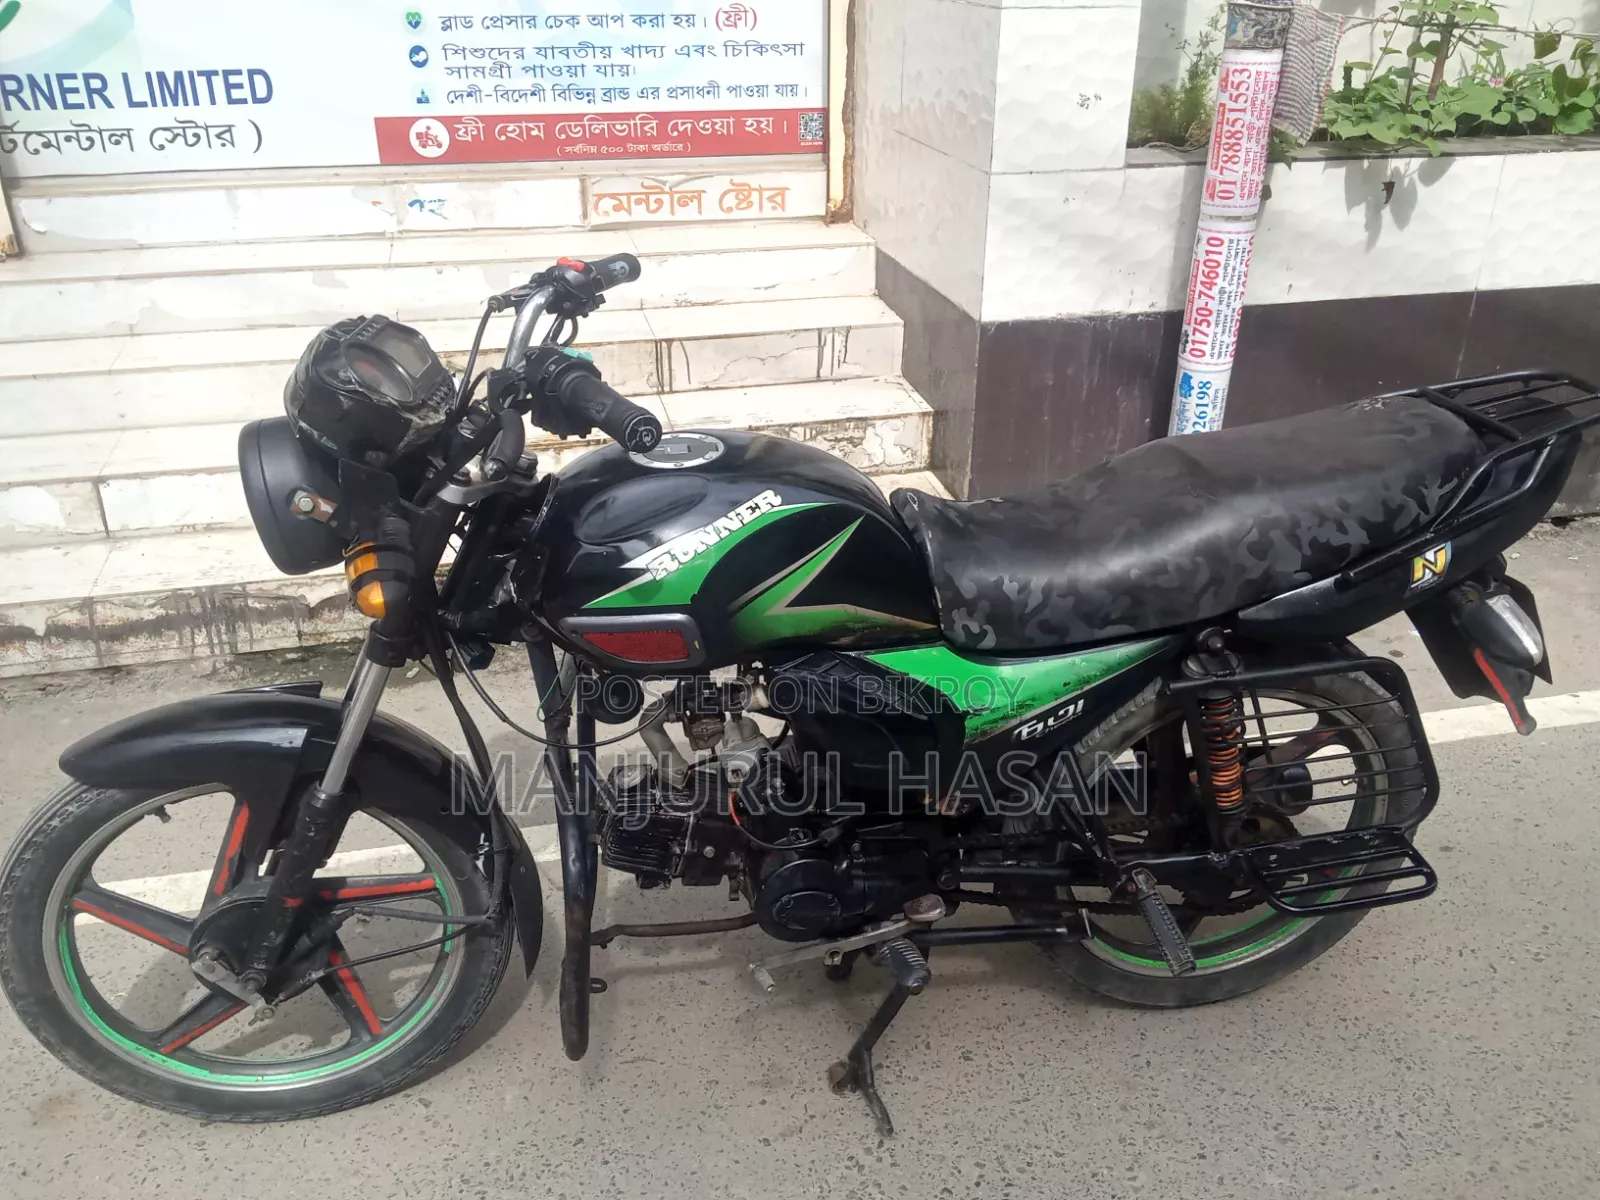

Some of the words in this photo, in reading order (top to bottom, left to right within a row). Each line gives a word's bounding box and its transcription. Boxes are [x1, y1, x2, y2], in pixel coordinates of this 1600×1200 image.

[438, 15, 474, 32] ব্লাড
[482, 14, 538, 30] প্রেসার
[546, 15, 580, 29] চেক
[586, 14, 624, 28] আপ
[630, 13, 665, 28] করা
[715, 3, 757, 31] (ফ্রী)
[442, 44, 526, 60] শিশুদের
[533, 41, 612, 60] যাবতীয়
[621, 44, 666, 58] খাদ্য
[674, 44, 717, 58] এবং
[723, 40, 805, 57] চিকিৎসা
[444, 61, 512, 80] সামগ্রী
[521, 64, 586, 78] পাওয়া
[122, 68, 273, 108] LIMITED
[446, 83, 546, 104] দেশী-বিদেশী
[551, 83, 596, 106] বিভিন্ন
[637, 86, 660, 100] এর
[667, 80, 720, 100] প্রসাধনী
[726, 84, 769, 98] পাওয়া
[149, 116, 236, 151] স্টোর
[453, 116, 486, 142] ফ্রী
[494, 121, 545, 142] হোম
[555, 114, 658, 140] ডেলিভারি
[668, 116, 735, 136] দেওয়া
[1216, 68, 1252, 200] 01788851553
[628, 143, 648, 153] টাকা
[1243, 147, 1252, 167] বাসা
[592, 182, 707, 217] মেন্টাল
[1189, 236, 1224, 358] 01750-746010
[646, 489, 782, 581] RUNNER
